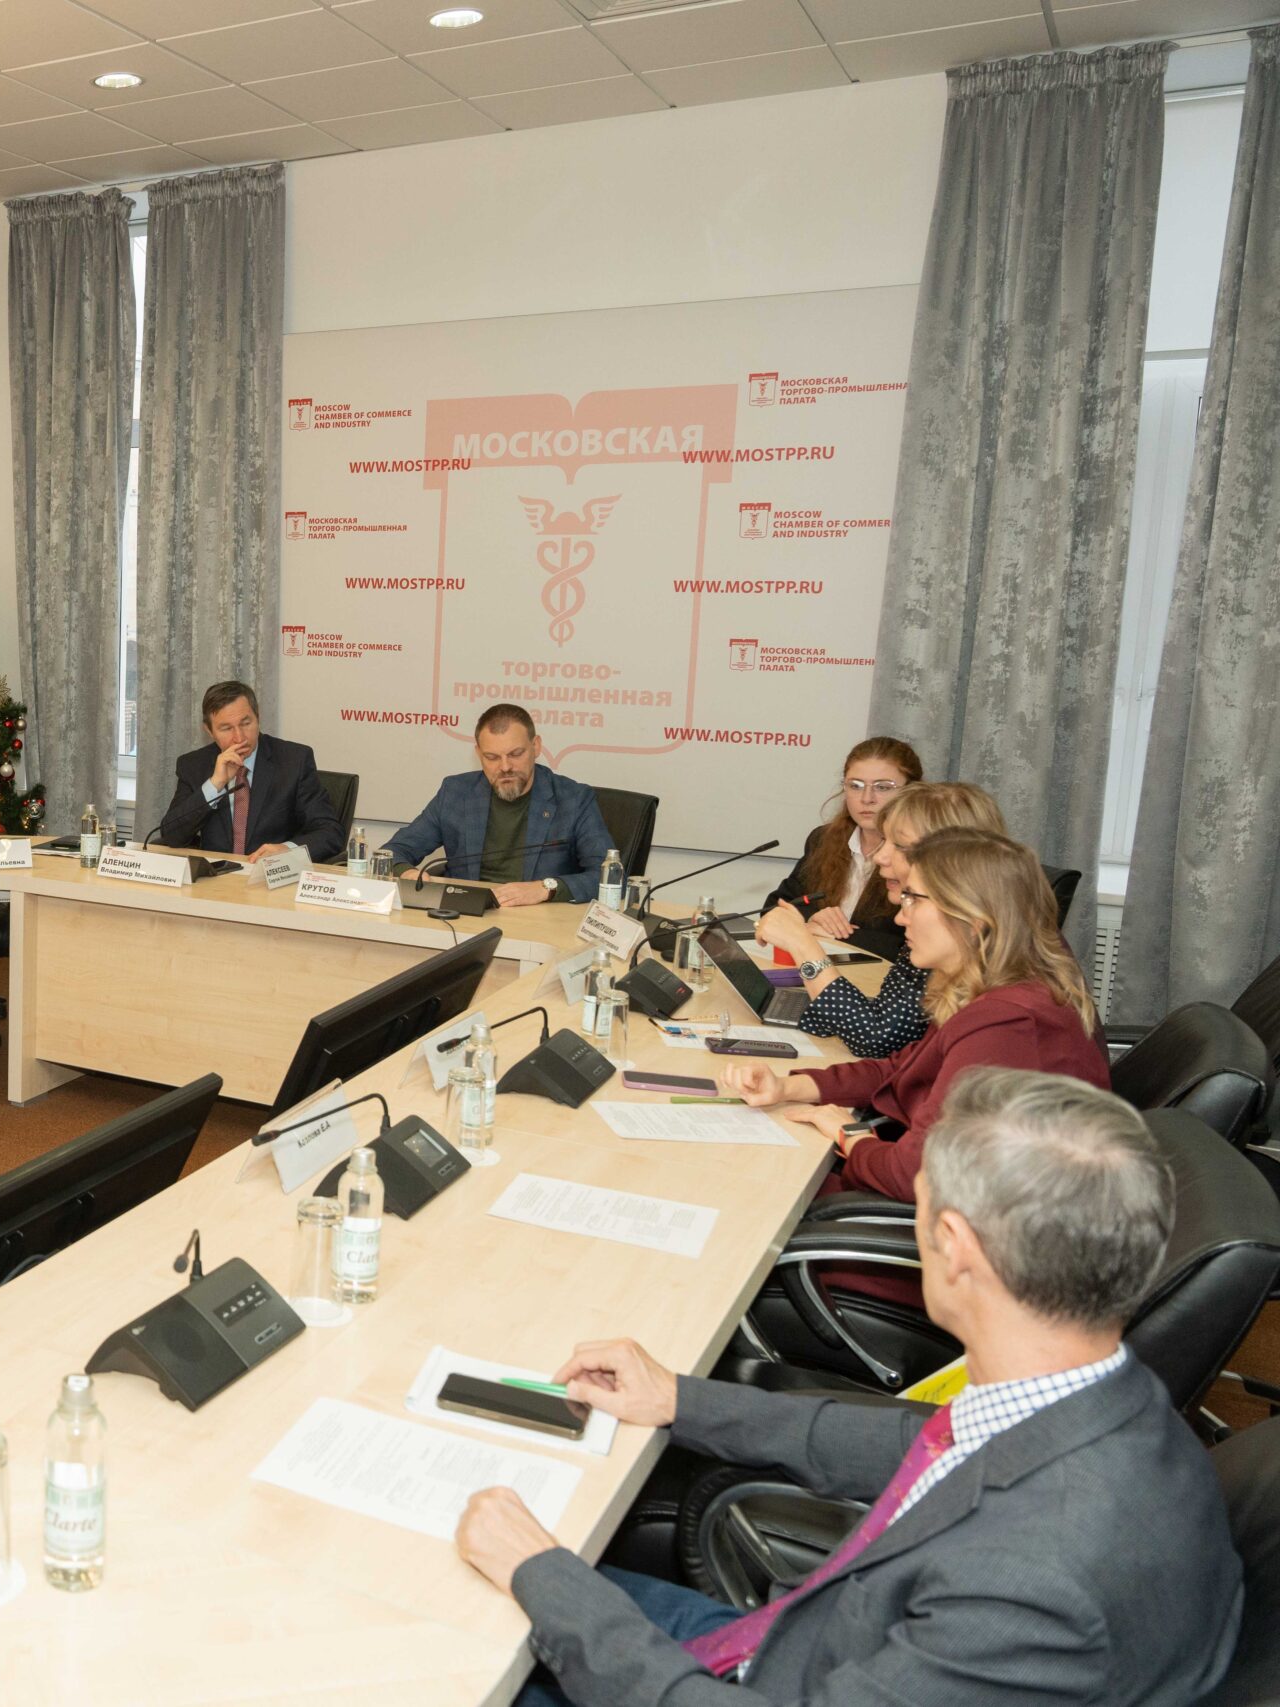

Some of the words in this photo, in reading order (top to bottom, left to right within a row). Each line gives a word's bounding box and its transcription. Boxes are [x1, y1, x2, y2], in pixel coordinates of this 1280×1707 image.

[780, 376, 848, 387] МОСКОВСКАЯ
[779, 396, 817, 405] ПАЛАТА
[314, 404, 351, 412] MOSCOW
[314, 412, 352, 421] CHAMBER
[354, 411, 365, 419] OF
[367, 409, 412, 418] COMMERCE
[314, 421, 331, 429] AND
[332, 420, 371, 428] INDUSTRY
[452, 424, 704, 460] МОСКОВСКАЯ
[682, 446, 835, 464] WWW.MOSTPP.RU
[349, 458, 471, 474] WWW.MOSTPP.RU
[773, 510, 822, 519] MOSCOW
[308, 517, 358, 525] МОСКОВСКАЯ
[773, 520, 824, 529] CHAMBER
[826, 520, 841, 528] OF
[308, 524, 407, 532] ТОРГОВО-ПРОМЫШЛЕННАЯ
[772, 530, 795, 539] AND
[796, 529, 849, 538] INDUSTRY
[345, 577, 465, 591] WWW.MOSTPP.RU
[673, 579, 824, 594] WWW.MOSTPP.RU
[307, 633, 343, 641] MOSCOW
[307, 641, 344, 650] CHAMBER
[346, 642, 356, 650] OF
[358, 643, 403, 652] COMMERCE
[760, 647, 826, 656] МОСКОВСКАЯ
[307, 649, 323, 657] AND
[324, 650, 363, 658] INDUSTRY
[502, 660, 621, 682] торгово-
[759, 664, 795, 672] ПАЛАТА
[453, 681, 672, 707] промышленная
[340, 709, 460, 727] WWW.MOSTPP.RU
[529, 708, 605, 728] алата
[664, 727, 812, 747] WWW.MOSTPP.RU
[102, 857, 141, 869] АЛЕНЦИН
[100, 867, 133, 877] Владимир
[302, 883, 336, 894] КРУТОВ
